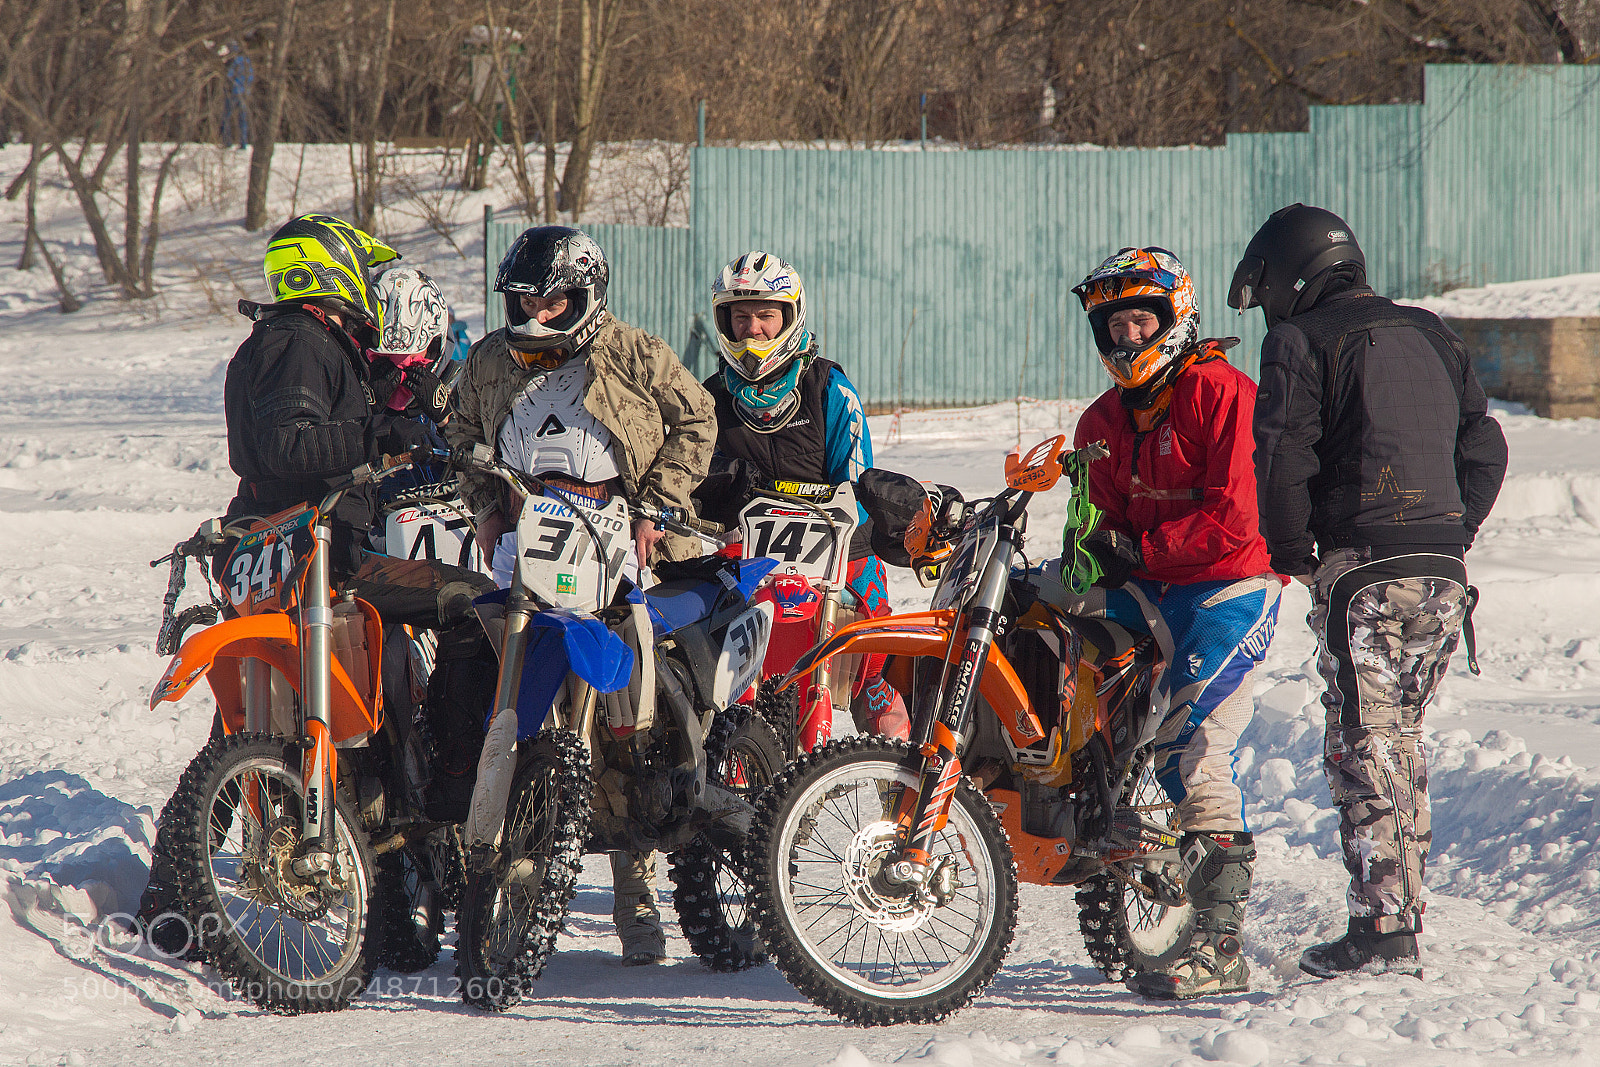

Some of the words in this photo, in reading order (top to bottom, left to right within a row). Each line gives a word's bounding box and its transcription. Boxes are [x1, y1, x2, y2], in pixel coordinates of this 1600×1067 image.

[576, 309, 606, 345] uve
[786, 418, 811, 429] metabo
[754, 520, 842, 565] 147
[230, 533, 294, 606] 341
[306, 787, 319, 825] KTM
